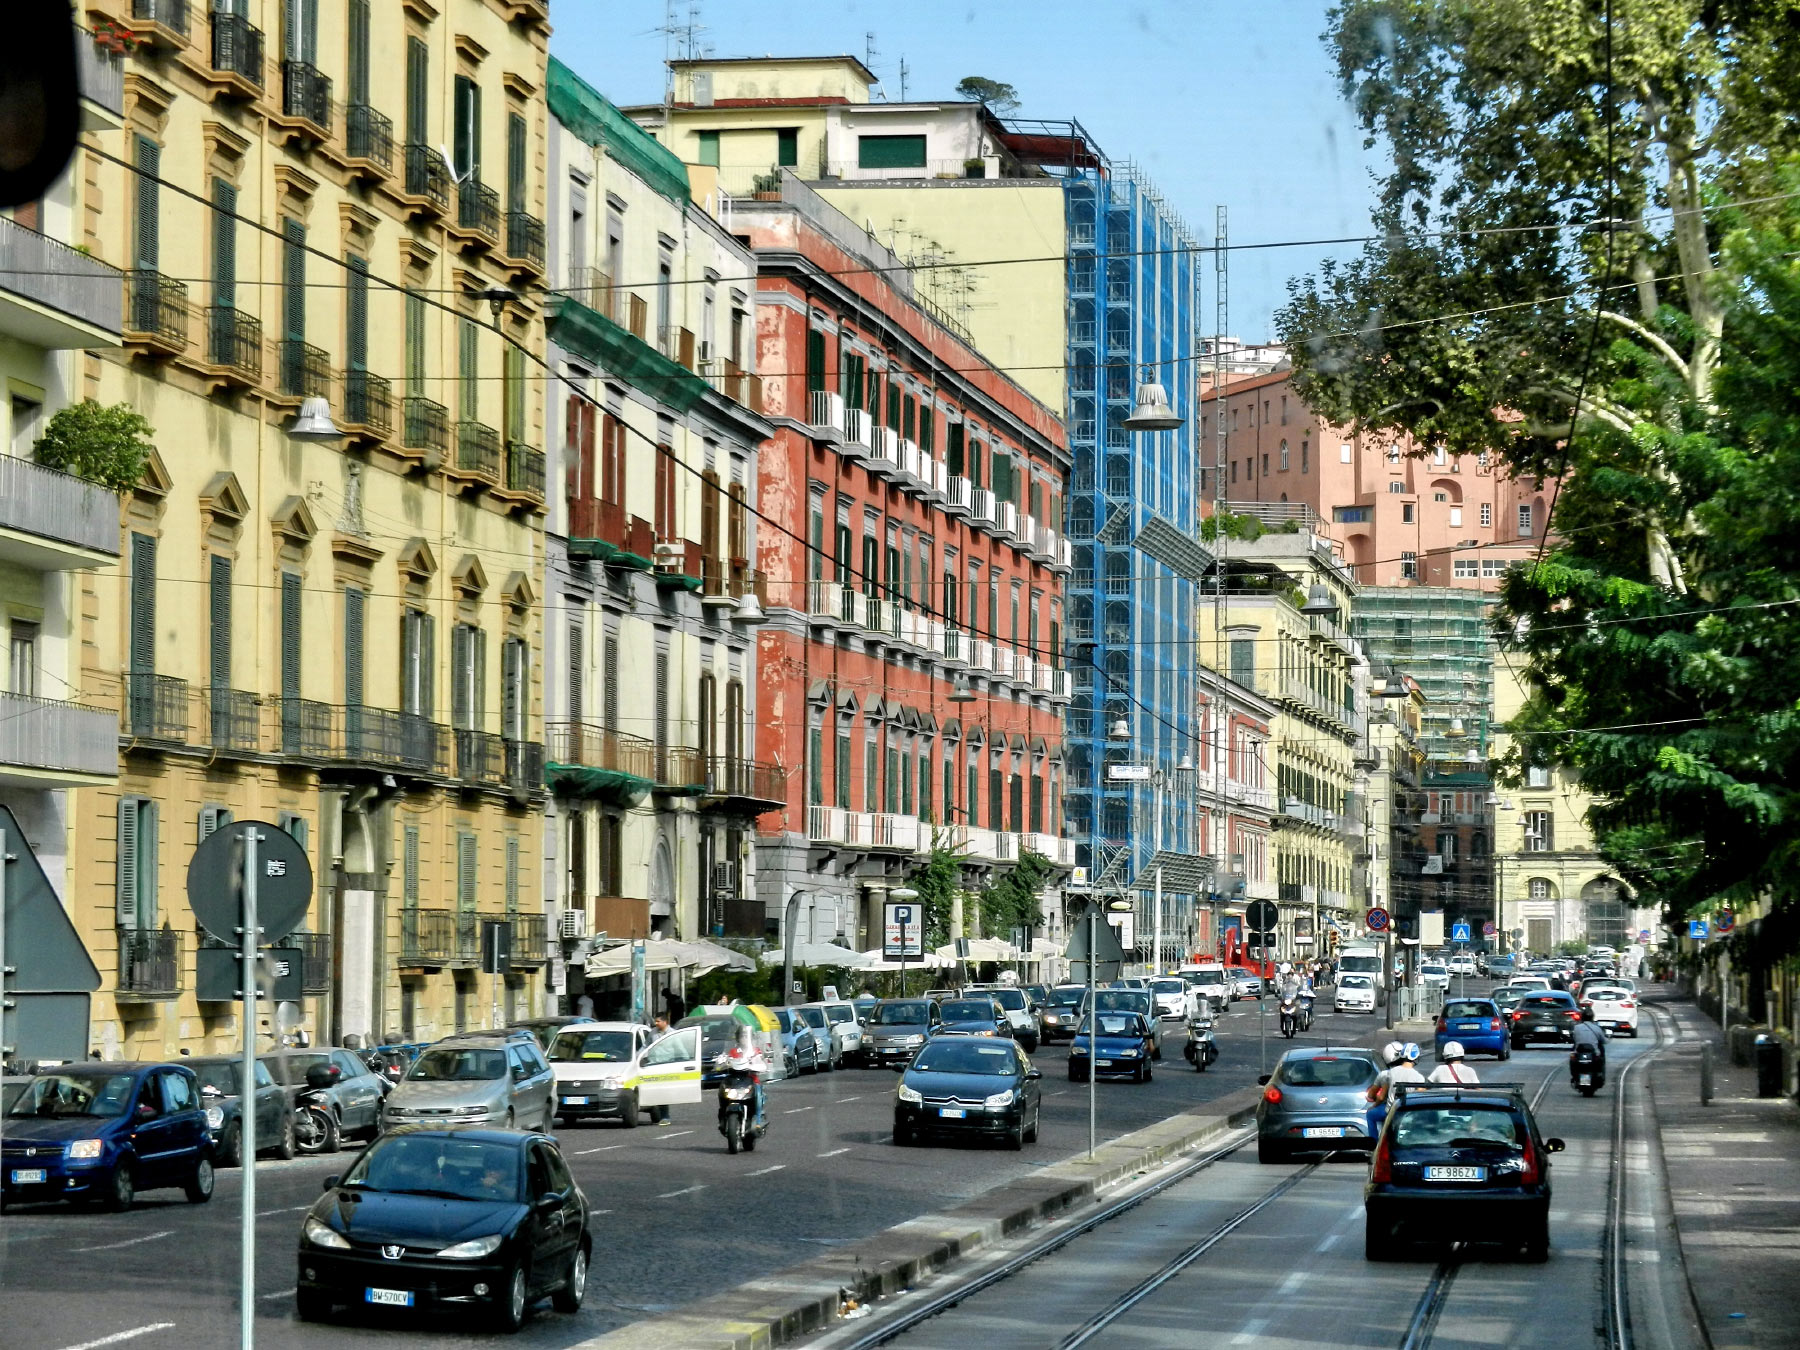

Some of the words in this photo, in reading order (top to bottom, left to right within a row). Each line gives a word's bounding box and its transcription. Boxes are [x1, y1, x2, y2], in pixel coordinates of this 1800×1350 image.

[898, 908, 909, 921] P
[1430, 1167, 1443, 1178] CF
[1446, 1167, 1477, 1178] 986ZX
